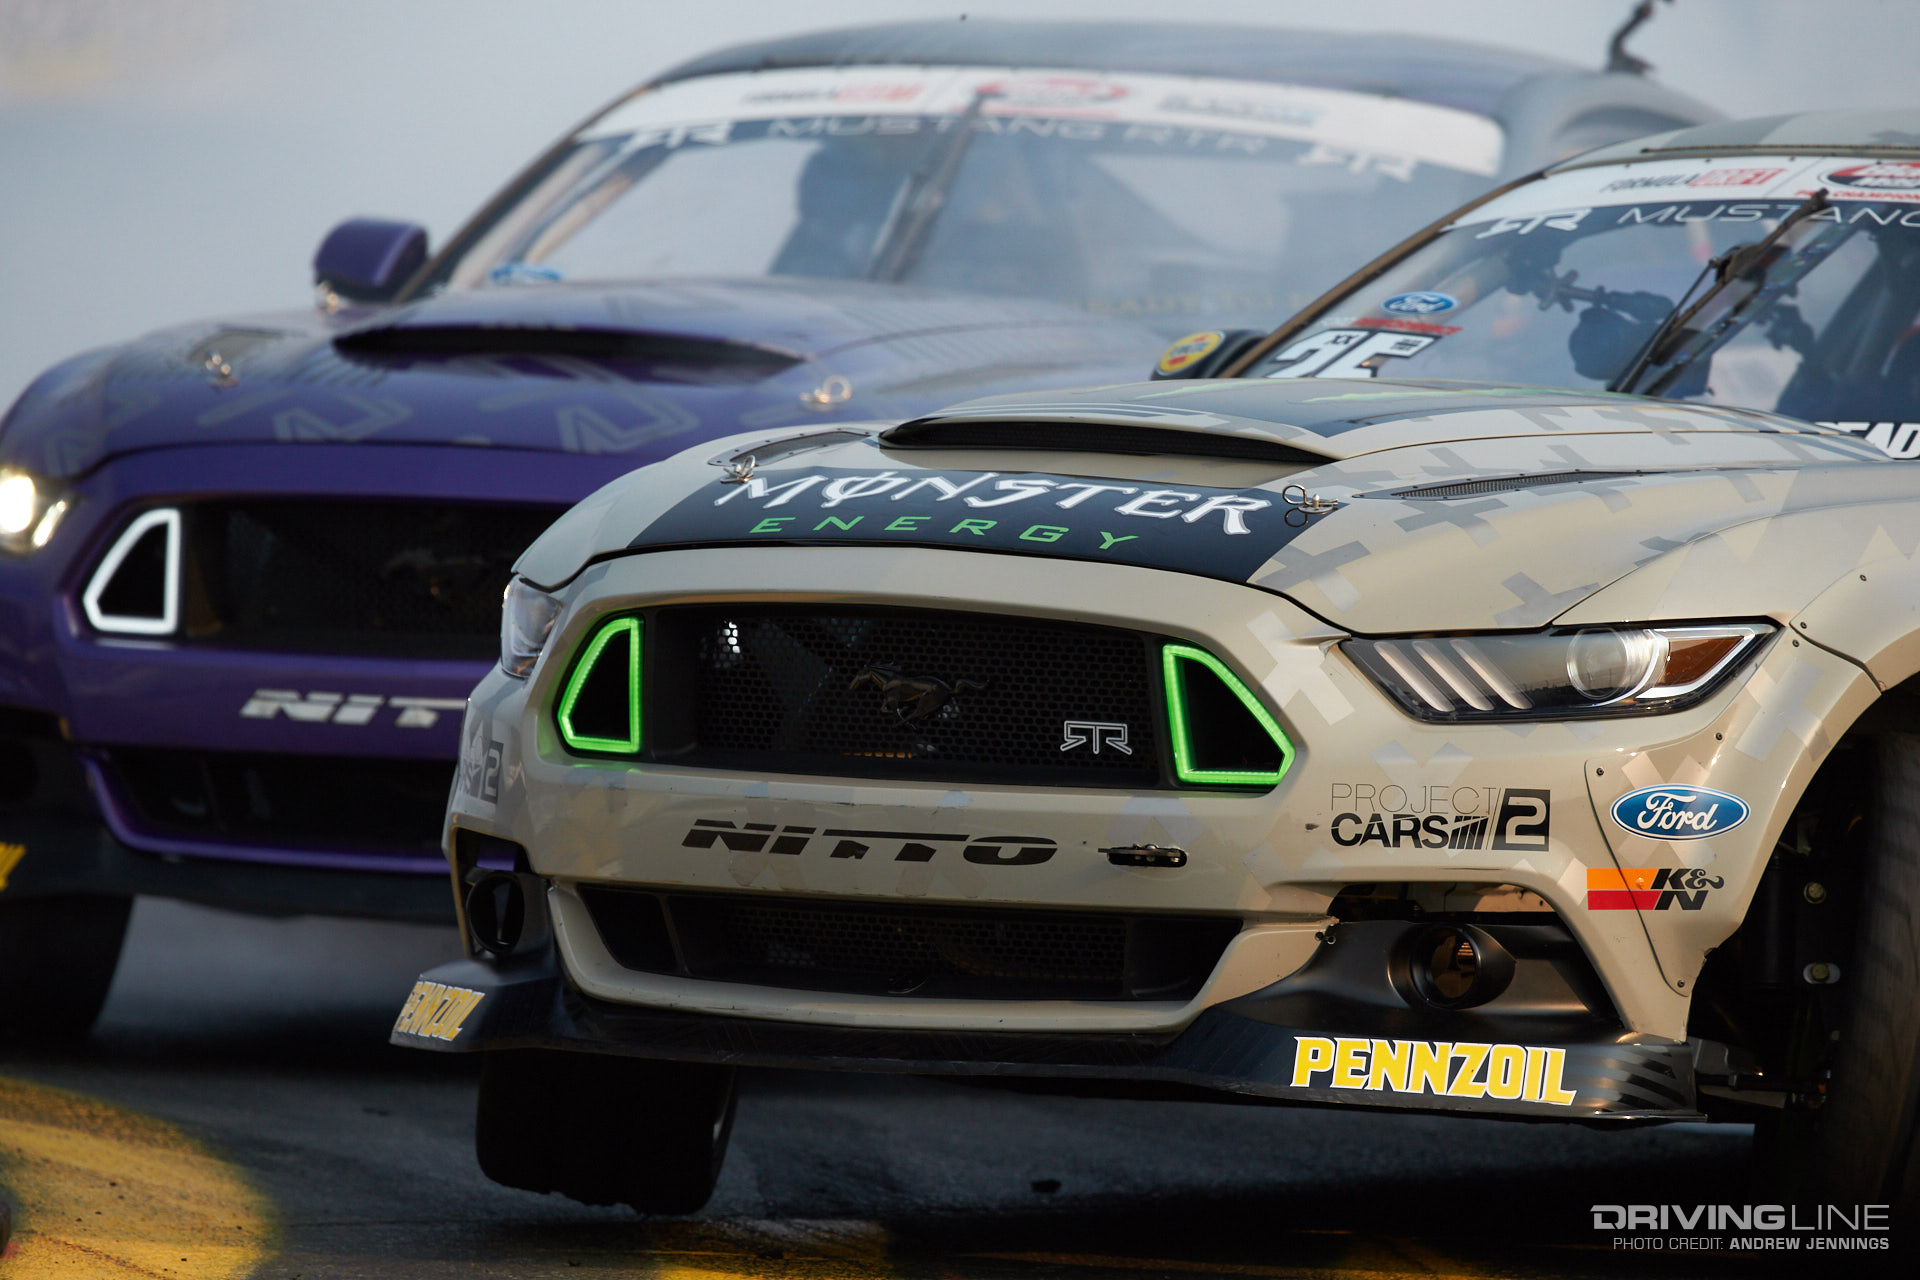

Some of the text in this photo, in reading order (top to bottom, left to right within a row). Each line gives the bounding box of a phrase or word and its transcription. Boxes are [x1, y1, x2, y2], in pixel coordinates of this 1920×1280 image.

[767, 113, 1105, 142] MUSTANG
[750, 516, 1138, 550] ENERGY
[239, 689, 468, 728] NIT
[1331, 783, 1497, 815] PROJECT
[1638, 791, 1720, 832] Ford
[1331, 793, 1549, 848] CARS 2
[681, 818, 1058, 866] NITTO
[1290, 1036, 1577, 1106] PENNZOIL
